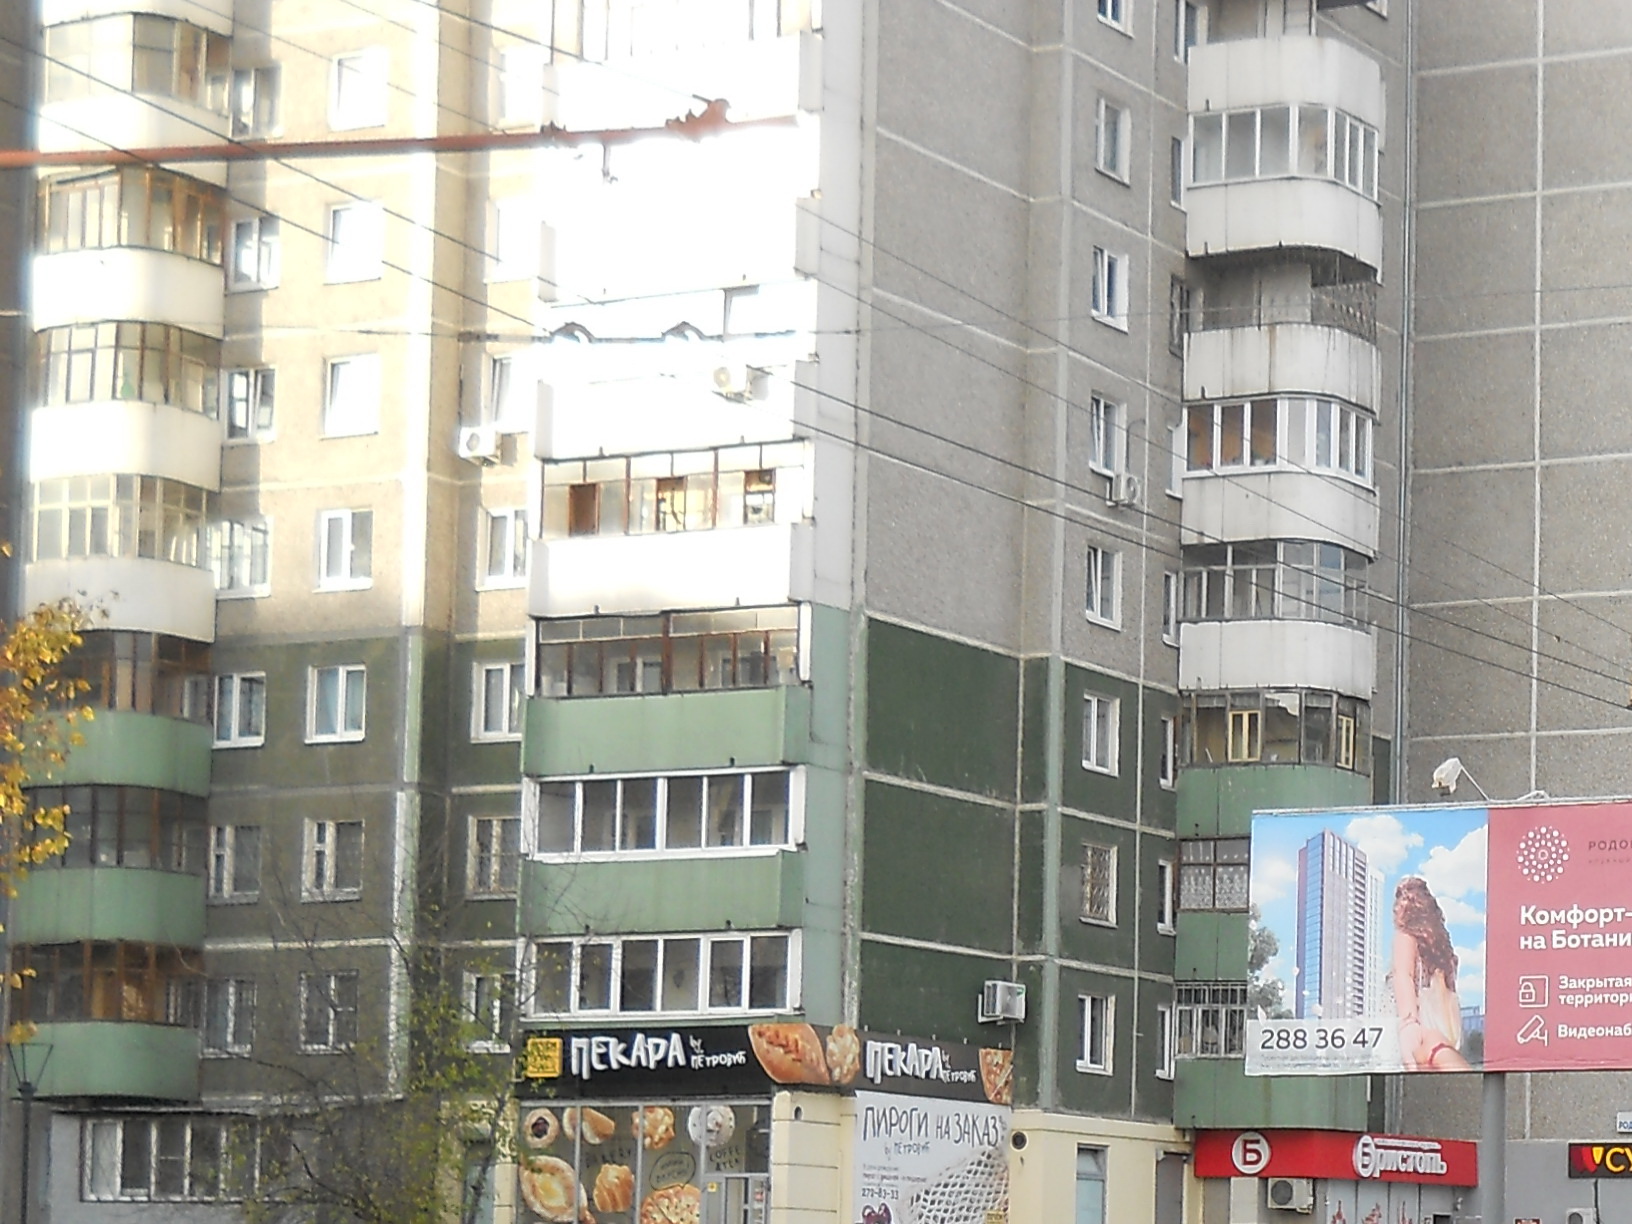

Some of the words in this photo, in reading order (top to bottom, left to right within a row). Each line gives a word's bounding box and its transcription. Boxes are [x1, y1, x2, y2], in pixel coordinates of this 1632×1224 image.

[1520, 934, 1546, 949] на
[1558, 976, 1632, 991] Закрытая
[571, 1033, 686, 1079] ПЕКАРА
[1261, 1029, 1307, 1049] 288
[1315, 1028, 1345, 1049] 36
[1353, 1028, 1383, 1048] 47
[866, 1041, 943, 1084] ПЕКАРА
[863, 1107, 928, 1141] ПИРОГИ
[936, 1115, 950, 1139] НА
[953, 1113, 998, 1147] ЗАКАЗ
[1358, 1135, 1447, 1178] Бристоль
